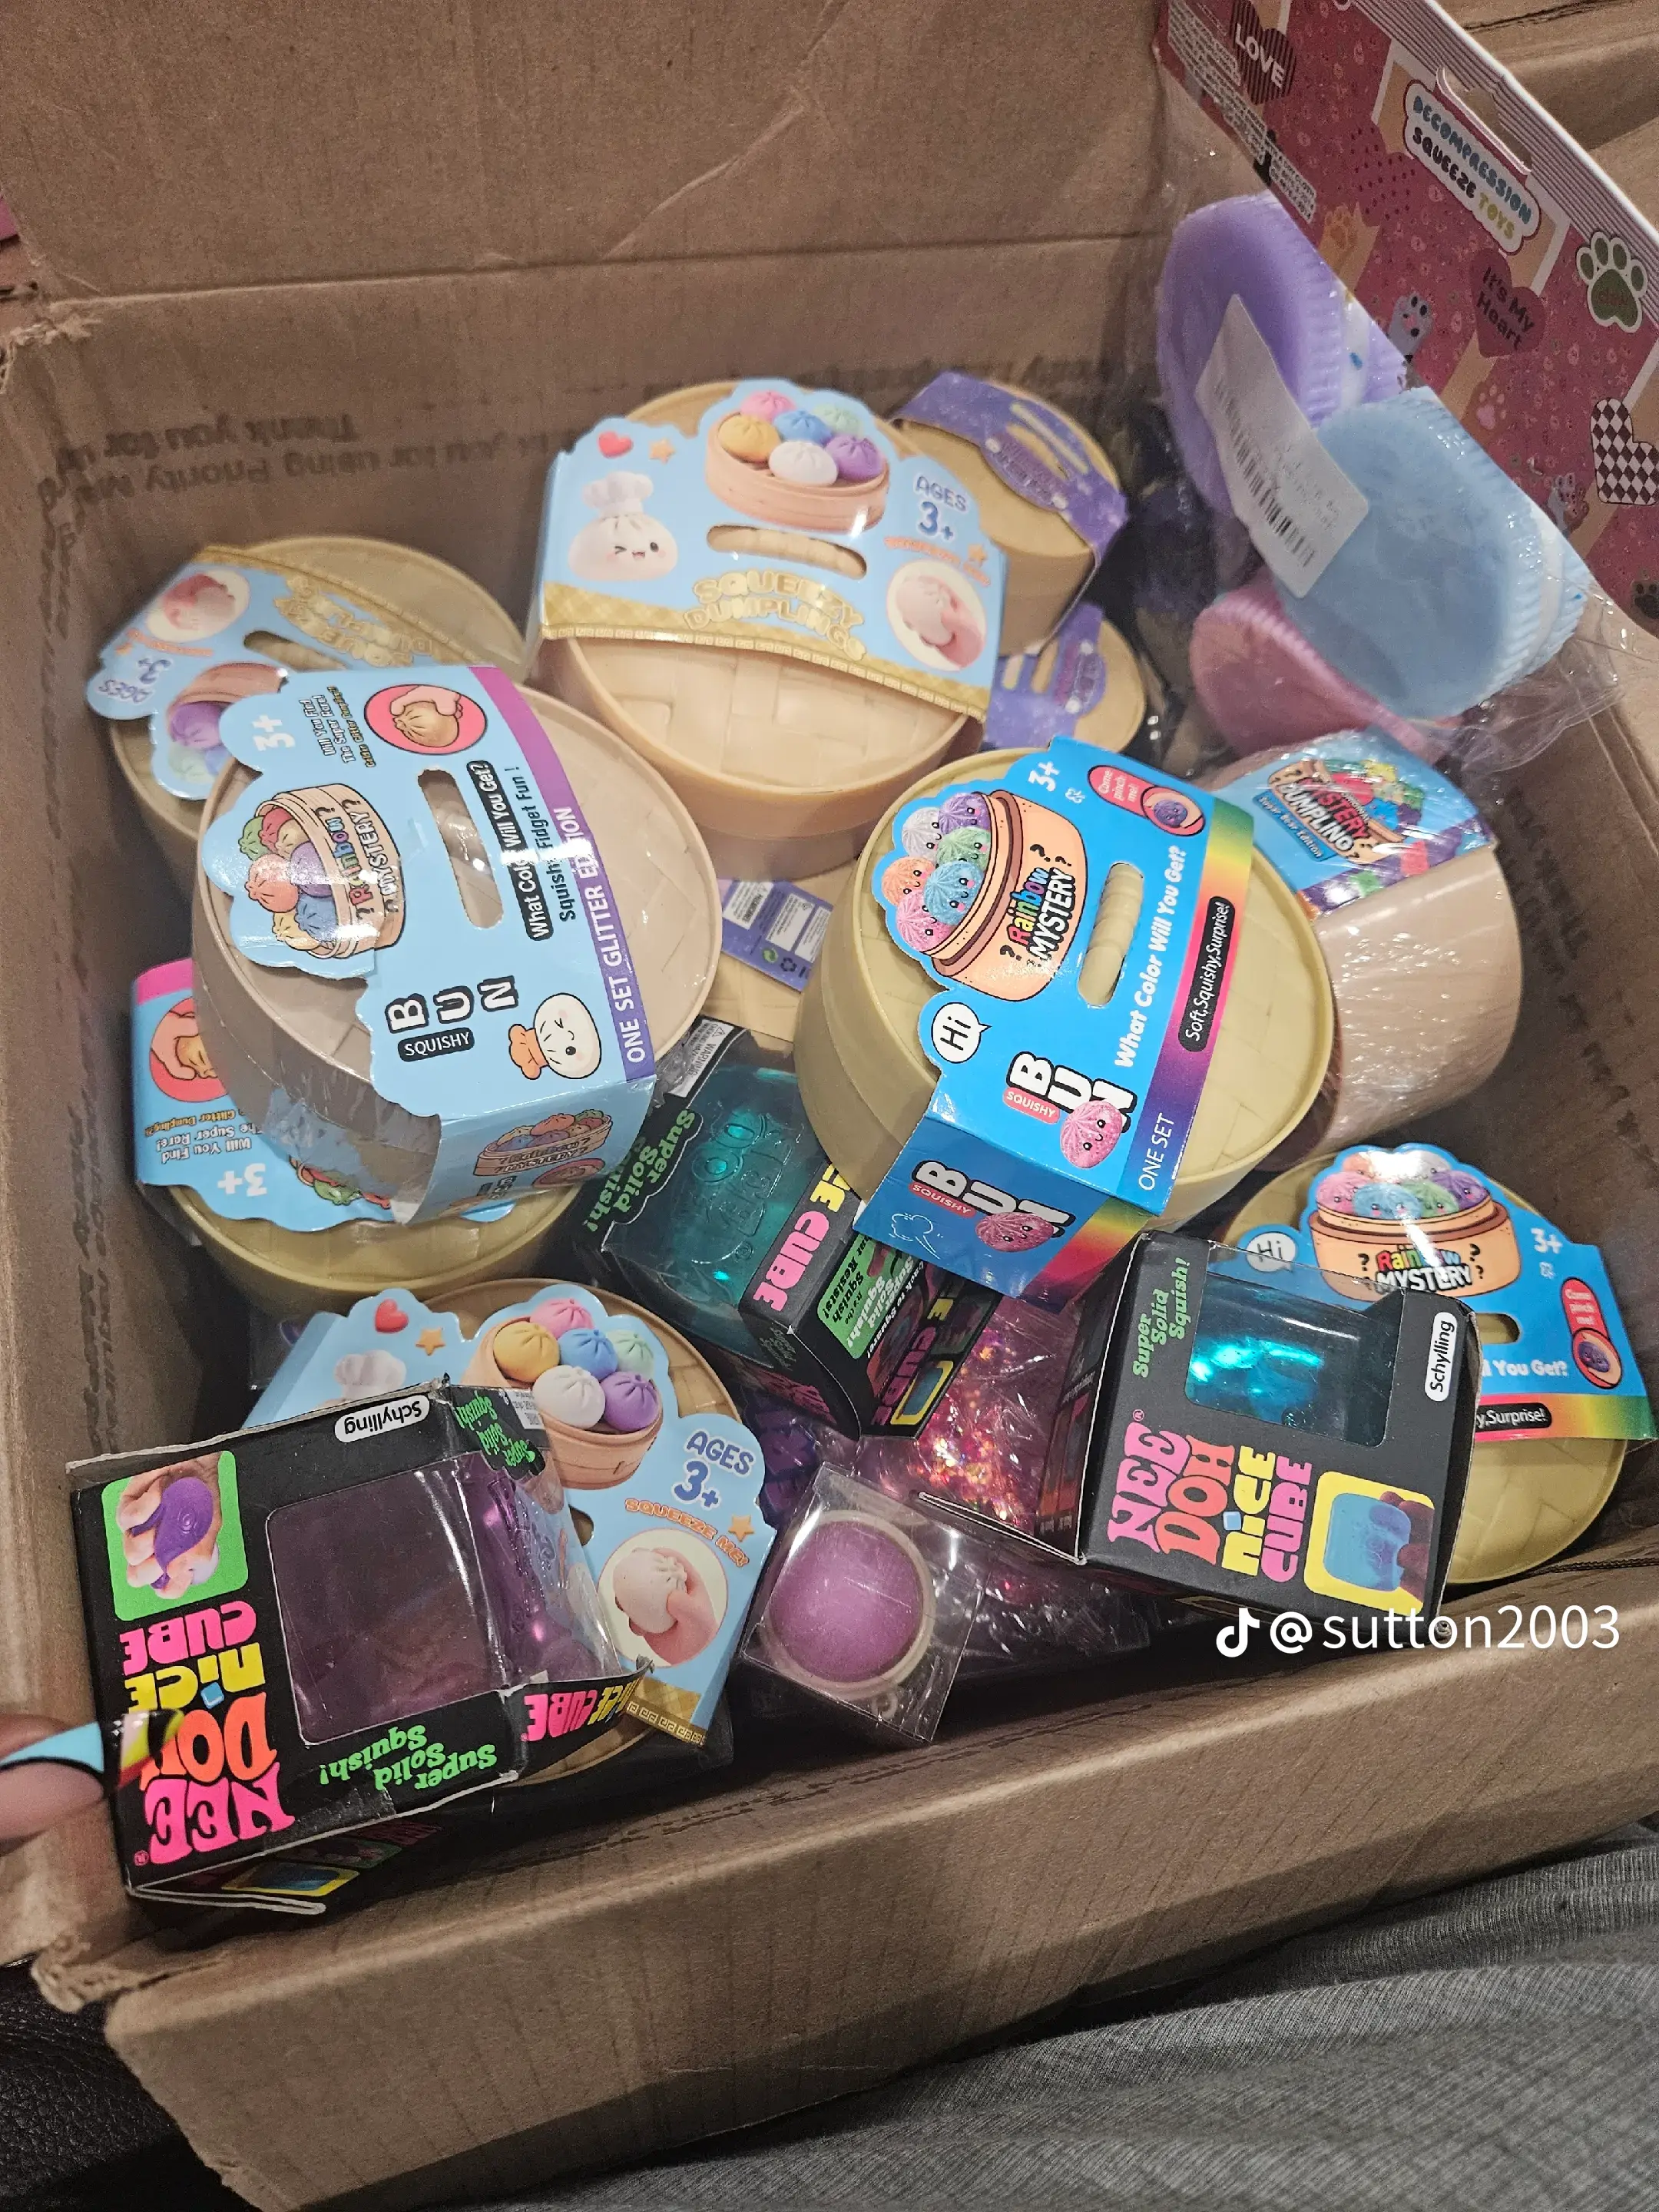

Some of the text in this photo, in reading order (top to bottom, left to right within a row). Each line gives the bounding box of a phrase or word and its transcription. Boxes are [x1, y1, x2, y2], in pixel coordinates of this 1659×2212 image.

[1236, 22, 1286, 88] LOVE
[1412, 127, 1514, 240] SQUEEZE TOYS
[1413, 95, 1532, 224] DECOMPRESSION
[1477, 290, 1523, 350] Heart
[1482, 267, 1535, 332] It's My
[916, 476, 967, 512] AGES
[917, 501, 955, 541] 3+
[252, 714, 296, 751] 3+
[299, 699, 336, 756] Will You Find
[327, 719, 346, 744] Super
[340, 746, 356, 763] The
[471, 763, 498, 792] Get?
[1028, 760, 1059, 792] 3+
[1098, 770, 1114, 795] Come
[489, 795, 507, 820] You
[528, 804, 554, 849] Fidget
[349, 811, 397, 896] MYSTERY
[496, 822, 522, 848] Will
[525, 895, 550, 938] What
[584, 886, 623, 969] GLITTER
[1008, 867, 1050, 945] Rainbow
[1029, 867, 1075, 960] MYSTERY
[1114, 845, 1187, 1068] What Color Will You Get?
[386, 976, 518, 1032] BUN
[608, 975, 634, 1010] SET
[403, 1032, 470, 1055] SQUISHY
[619, 1018, 646, 1063] ONE
[939, 1015, 971, 1051] Hi
[200, 1109, 235, 1121] Glitter
[1005, 1091, 1057, 1119] SQUISHY
[156, 1133, 190, 1151] Rare!
[161, 1137, 251, 1164] Will You Find
[194, 1124, 235, 1141] Super
[647, 1110, 695, 1183] Super
[1138, 1113, 1174, 1191] ONE SET
[217, 1163, 267, 1197] 3+
[613, 1146, 658, 1212] Solid
[912, 1184, 972, 1215] SQUISHY
[753, 1210, 830, 1312] CUBE
[1255, 1240, 1284, 1260] Hi
[1531, 1228, 1562, 1254] 3+
[823, 1257, 859, 1320] Resists!
[832, 1270, 864, 1323] Squish
[885, 1257, 915, 1311] Super
[1168, 1257, 1190, 1339] Squish!
[1375, 1264, 1472, 1292] MYSTERY
[847, 1275, 885, 1348] Squish!
[868, 1277, 894, 1329] Solid
[1150, 1288, 1170, 1345] Solid
[1133, 1313, 1151, 1377] Super
[1429, 1320, 1455, 1392] Schylling
[1497, 1361, 1529, 1377] You
[1533, 1359, 1568, 1377] Get?
[343, 1402, 422, 1434] Schylling
[476, 1422, 508, 1455] Solid
[502, 1438, 535, 1466] Super
[685, 1430, 755, 1475] AGES
[673, 1461, 720, 1510] 3+
[1154, 1434, 1235, 1565] DOH
[624, 1498, 750, 1568] SQUEEZE ME!
[1261, 1455, 1313, 1582] CUBE
[119, 1600, 256, 1676] CUBE
[524, 1689, 598, 1742] CUBE
[320, 1725, 427, 1784] Squish!
[373, 1743, 447, 1792] Solid
[414, 1745, 497, 1790] Super
